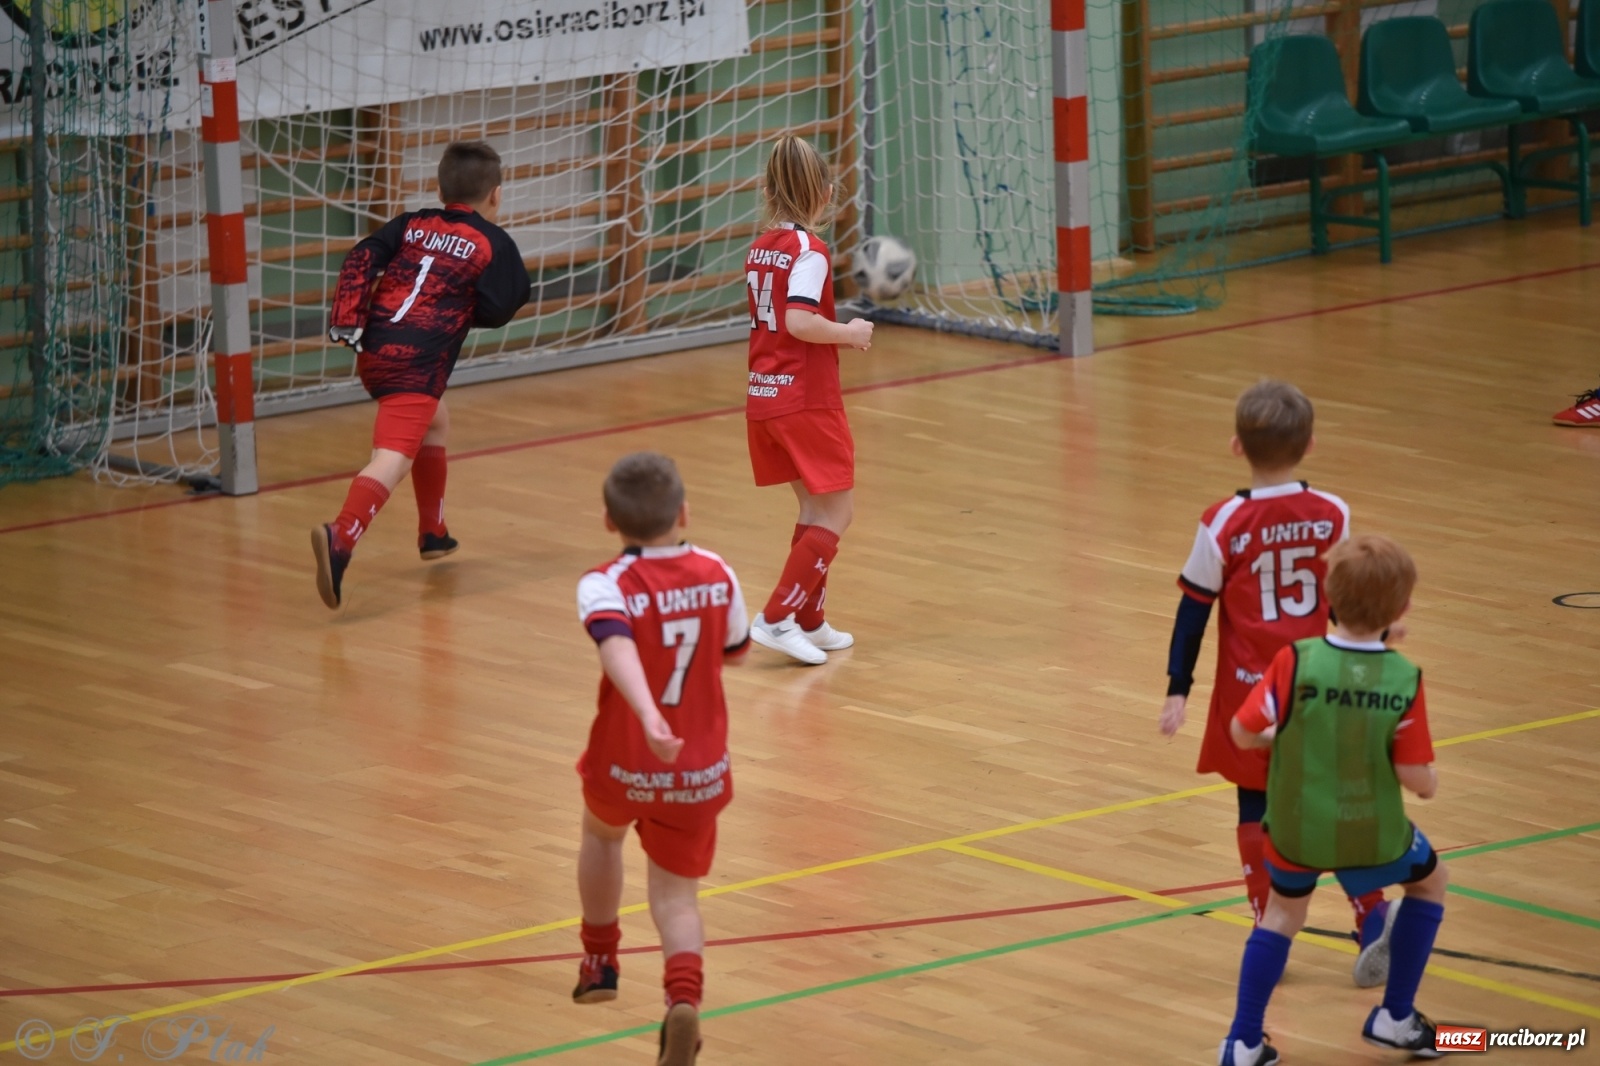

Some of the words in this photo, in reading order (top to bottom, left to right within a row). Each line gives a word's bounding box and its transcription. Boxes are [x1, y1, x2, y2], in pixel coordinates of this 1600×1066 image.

[405, 227, 425, 244] AP
[422, 229, 477, 259] UNITED
[389, 254, 435, 324] 1
[1252, 547, 1318, 621] 15
[661, 617, 700, 705] 7
